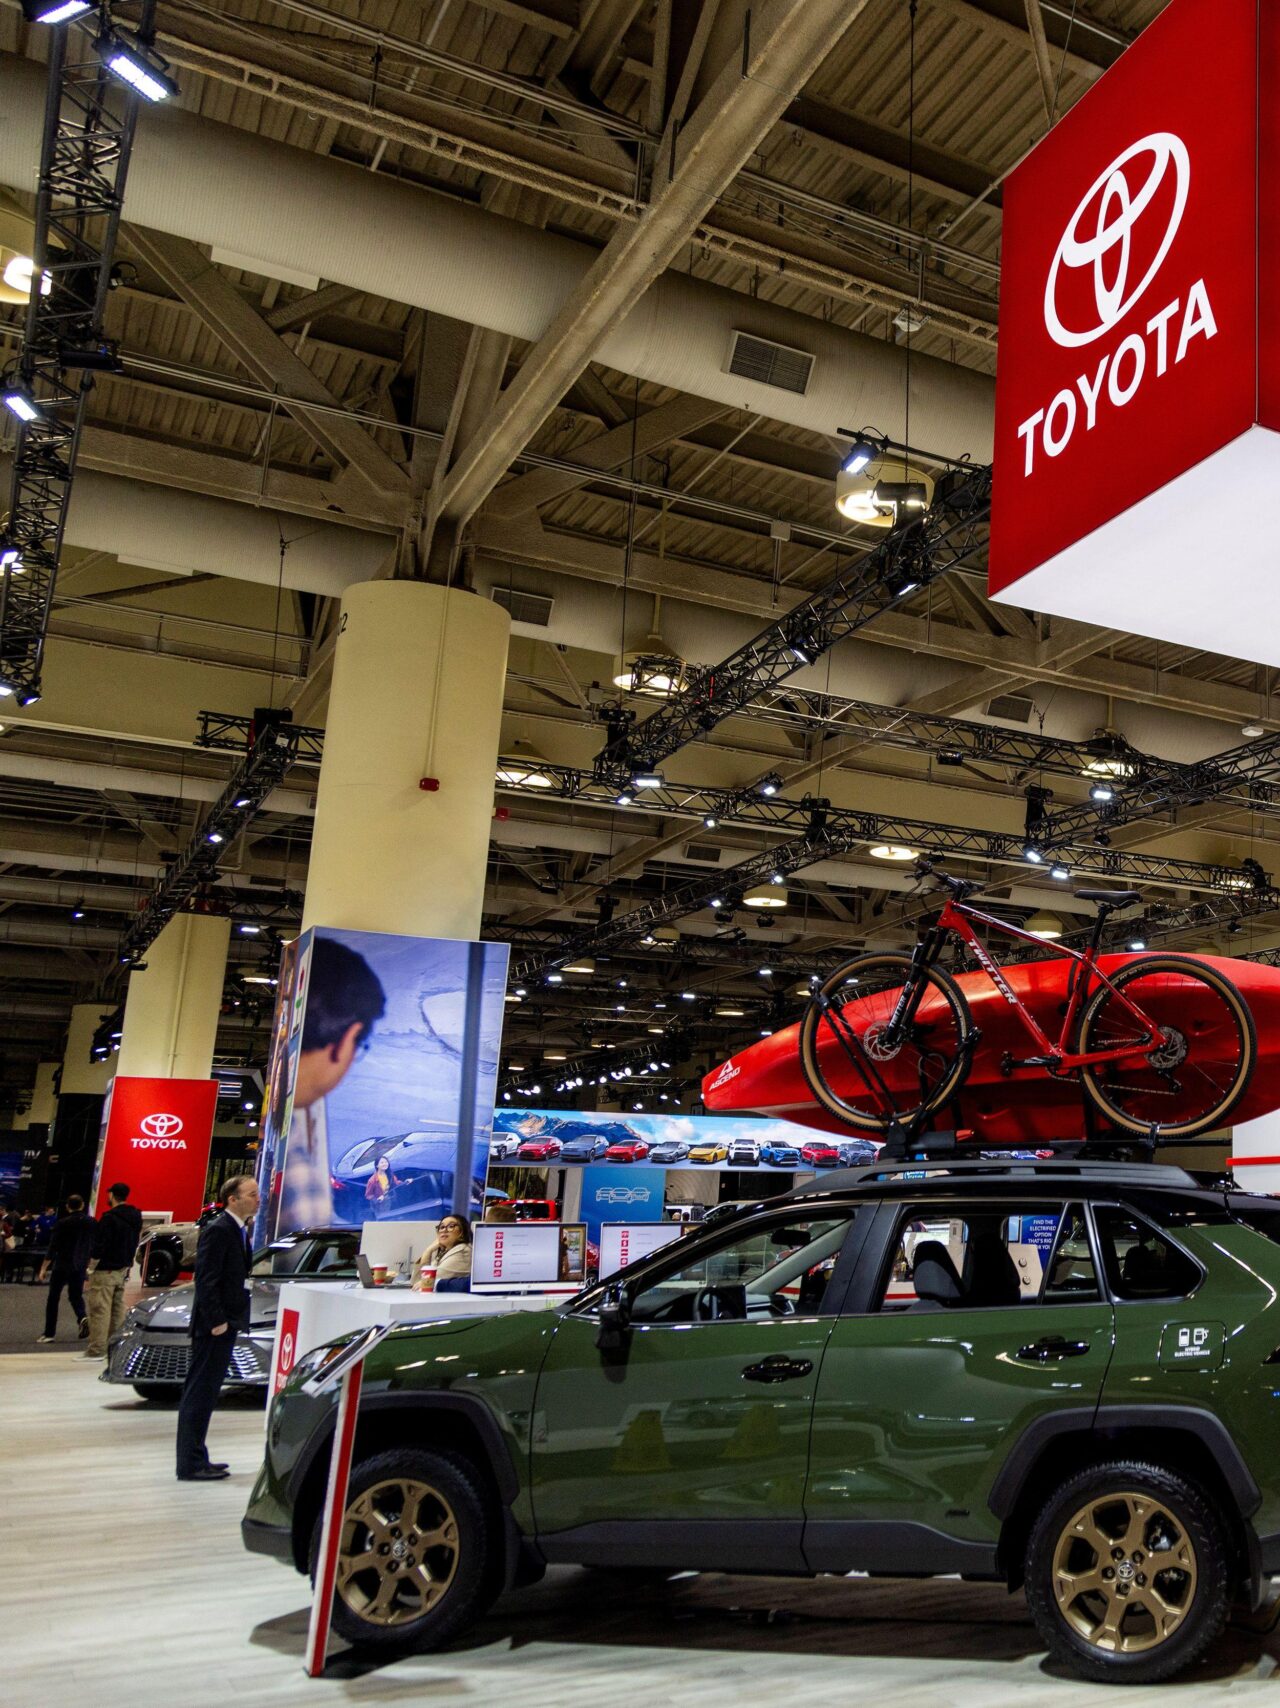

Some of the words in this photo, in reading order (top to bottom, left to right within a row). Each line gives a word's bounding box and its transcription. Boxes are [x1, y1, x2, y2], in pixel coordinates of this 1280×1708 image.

[1018, 278, 1218, 477] TOYOTA
[968, 938, 1018, 1004] TWITTER
[709, 1066, 741, 1091] ASCEND
[131, 1138, 187, 1149] TOYOTA
